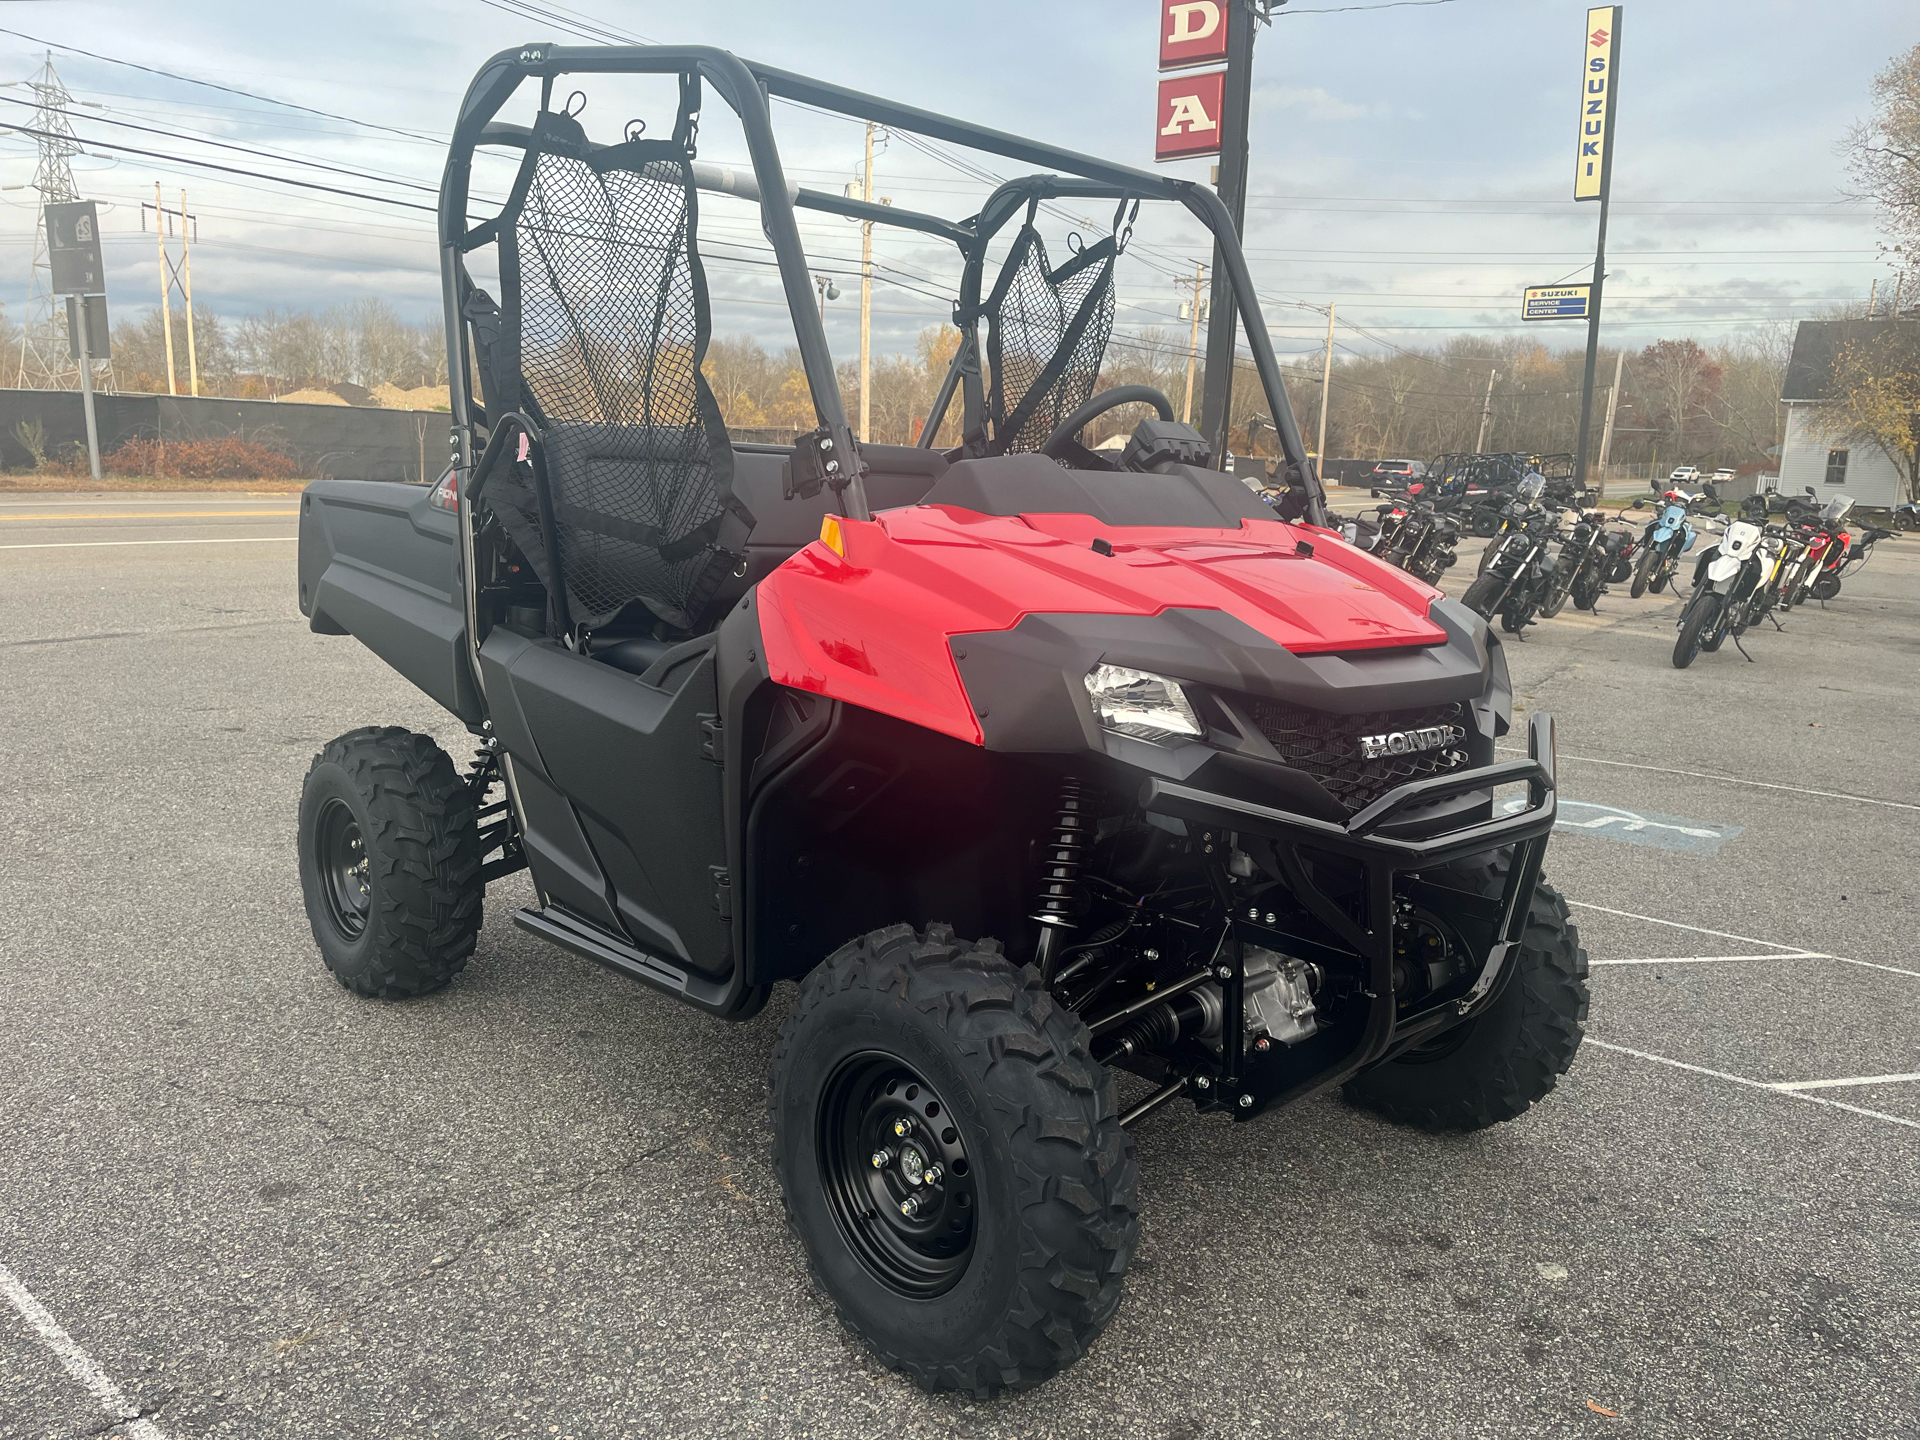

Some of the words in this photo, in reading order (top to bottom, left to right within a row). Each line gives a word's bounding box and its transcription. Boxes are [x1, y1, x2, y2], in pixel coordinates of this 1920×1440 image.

[1583, 57, 1606, 178] SUZUKI
[1540, 290, 1578, 298] SUZUKI
[1357, 725, 1456, 759] HONDA
[899, 1020, 990, 1148] KENDA
